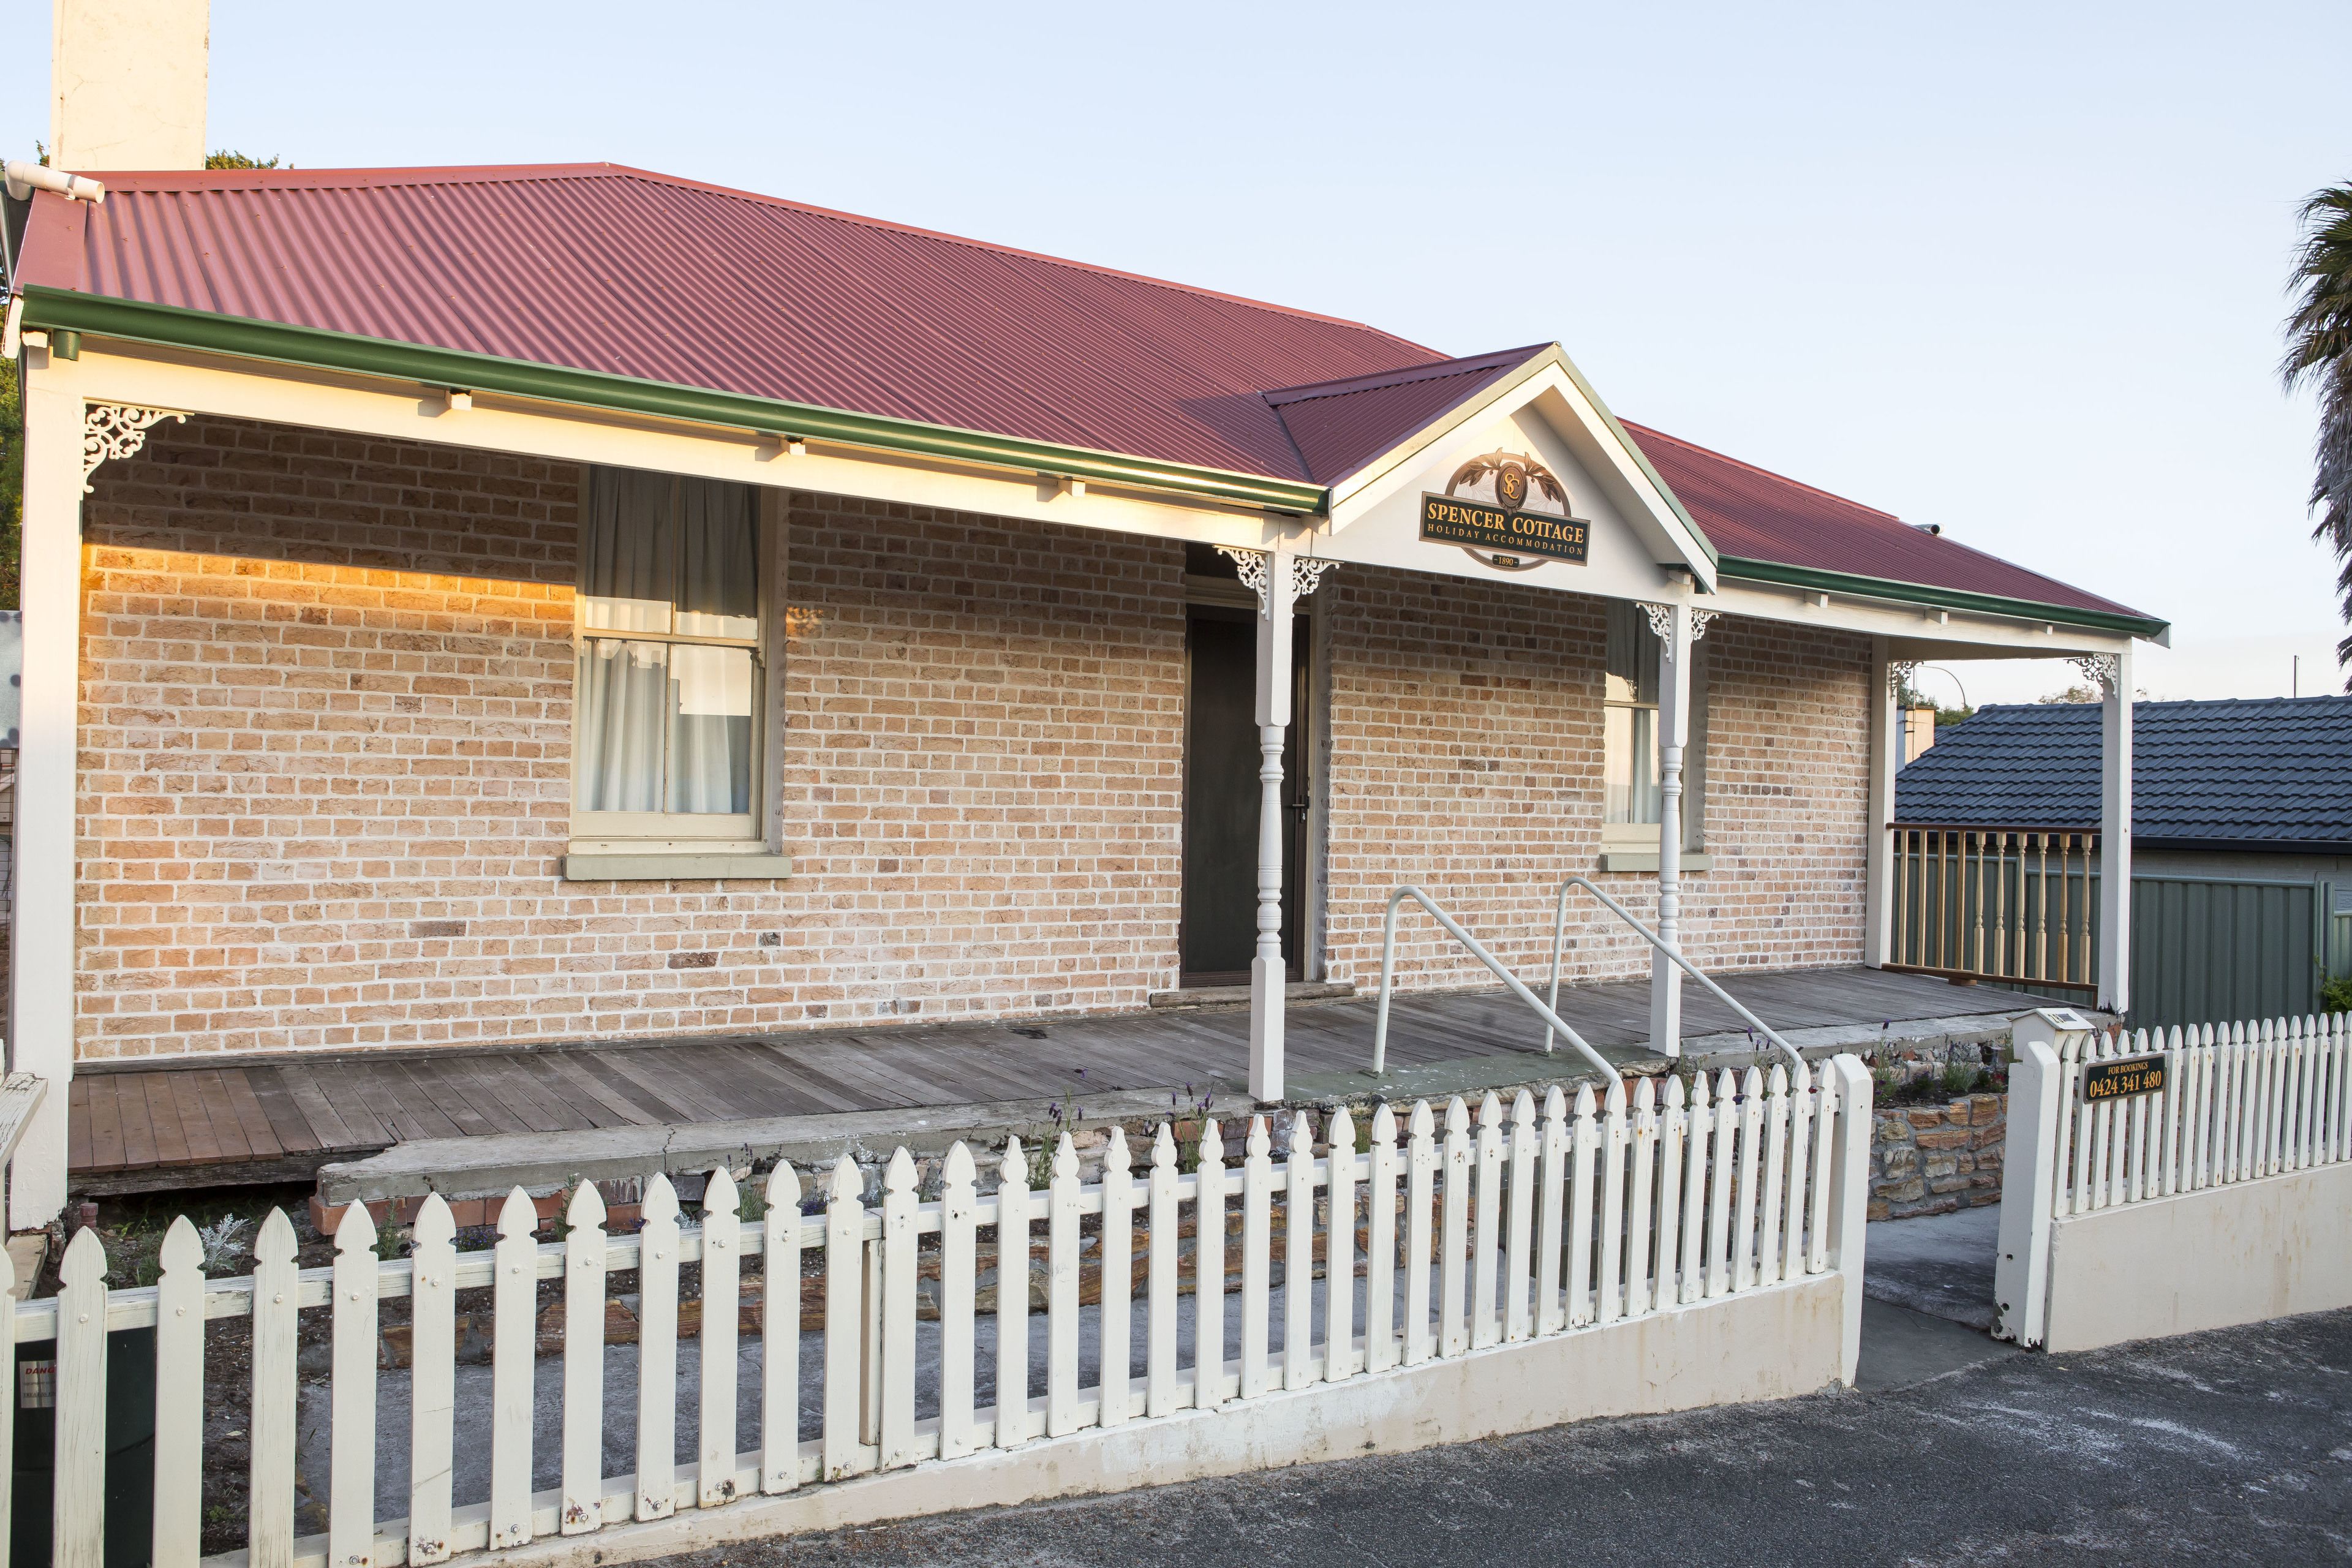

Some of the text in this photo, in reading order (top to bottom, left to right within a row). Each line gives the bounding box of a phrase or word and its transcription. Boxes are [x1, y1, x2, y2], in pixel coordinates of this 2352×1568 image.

[1428, 502, 1584, 543] SPENCER COTTAGE
[1427, 524, 1583, 555] HOLIDAY ACCOMMODATION
[2108, 1061, 2149, 1075] FOR BOOKINGS
[2090, 1071, 2162, 1098] 0424 341 480
